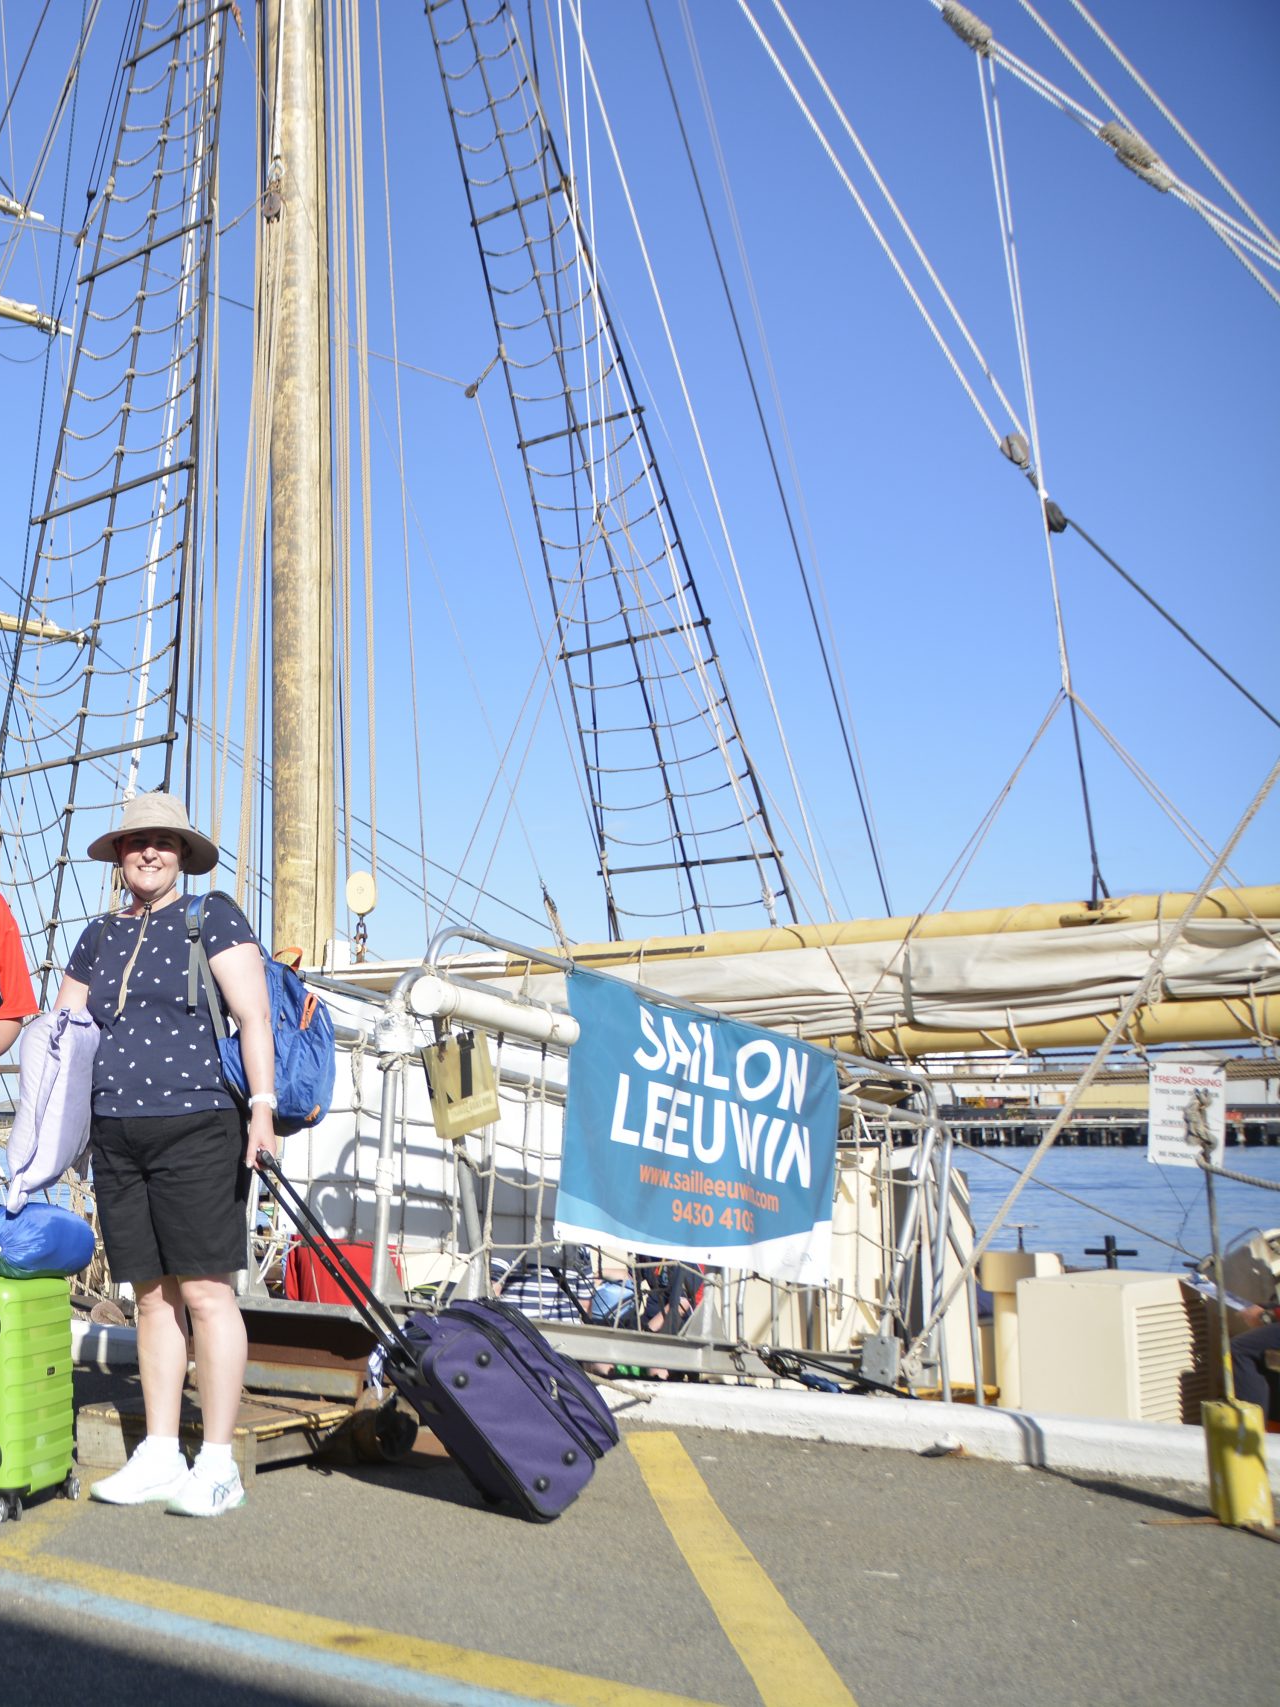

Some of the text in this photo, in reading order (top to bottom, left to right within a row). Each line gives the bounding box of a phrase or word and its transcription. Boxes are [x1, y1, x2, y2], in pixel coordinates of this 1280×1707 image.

[633, 1005, 809, 1115] SAIL ON
[1179, 1066, 1194, 1075] NO
[1154, 1075, 1222, 1088] TRESPASSING
[610, 1072, 811, 1189] LEEUWIN
[640, 1164, 779, 1213] www.sailleeuwin.com
[672, 1198, 755, 1234] 9430 4105
